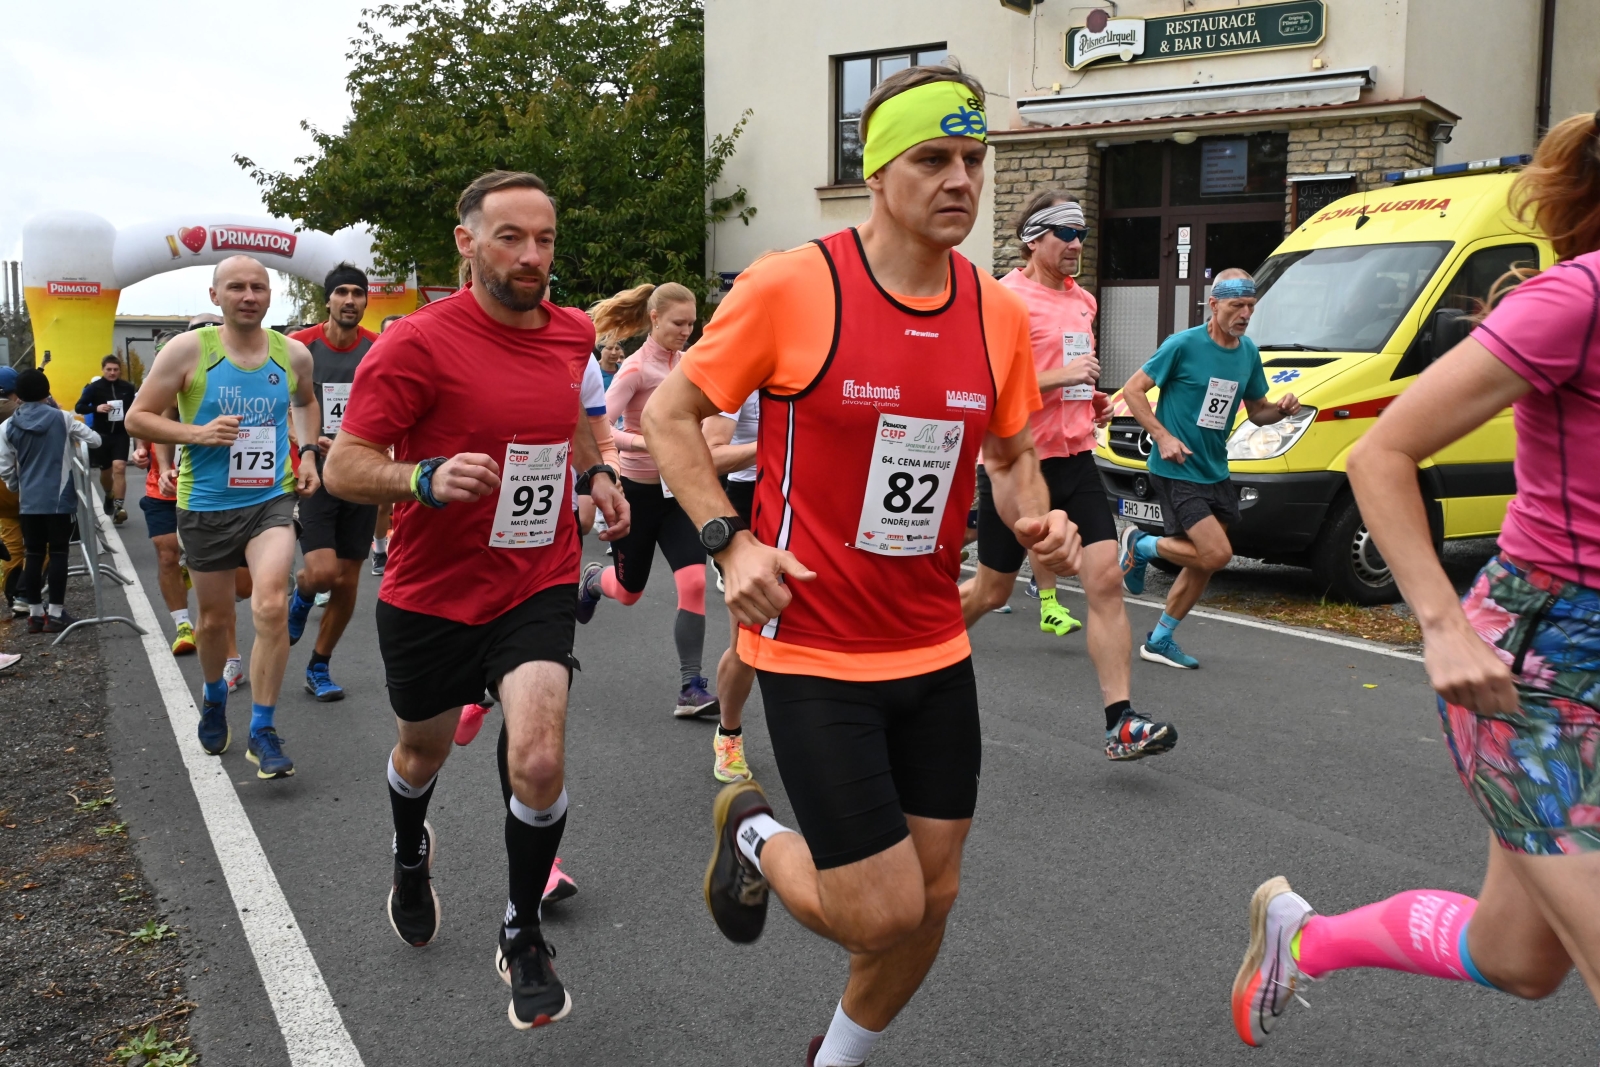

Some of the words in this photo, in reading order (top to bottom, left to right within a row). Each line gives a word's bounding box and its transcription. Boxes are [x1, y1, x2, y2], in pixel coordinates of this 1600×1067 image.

[1165, 12, 1256, 36] RESTAURACE
[1079, 33, 1107, 57] Pilsner
[1106, 29, 1136, 47] Urquell
[1160, 40, 1171, 53] &
[1174, 36, 1202, 52] BAR
[1206, 34, 1217, 48] U
[1220, 29, 1261, 47] SAMA
[214, 228, 291, 252] PRIMATOR
[49, 282, 99, 294] PRIMATOR
[218, 386, 242, 399] THE
[842, 379, 901, 400] Krakonoš
[946, 390, 986, 403] MARATON
[217, 397, 277, 415] WIKOV
[330, 402, 347, 418] 4
[873, 400, 900, 408] Trutnov
[1208, 398, 1229, 414] 87
[882, 421, 907, 430] PRIMATOR
[881, 428, 906, 440] CUP
[232, 451, 275, 471] 173
[509, 454, 529, 462] CUP
[881, 455, 895, 465] 64.
[897, 457, 921, 468] CENA
[923, 459, 952, 471] METUJE
[510, 474, 521, 482] 64.
[540, 472, 562, 481] METUJE
[511, 484, 555, 517] 93
[882, 471, 940, 514] 82
[1124, 501, 1138, 516] 5H3
[510, 519, 529, 527] MATĚJ
[880, 517, 910, 528] ONDŘEJ
[911, 517, 931, 527] KUBÍK
